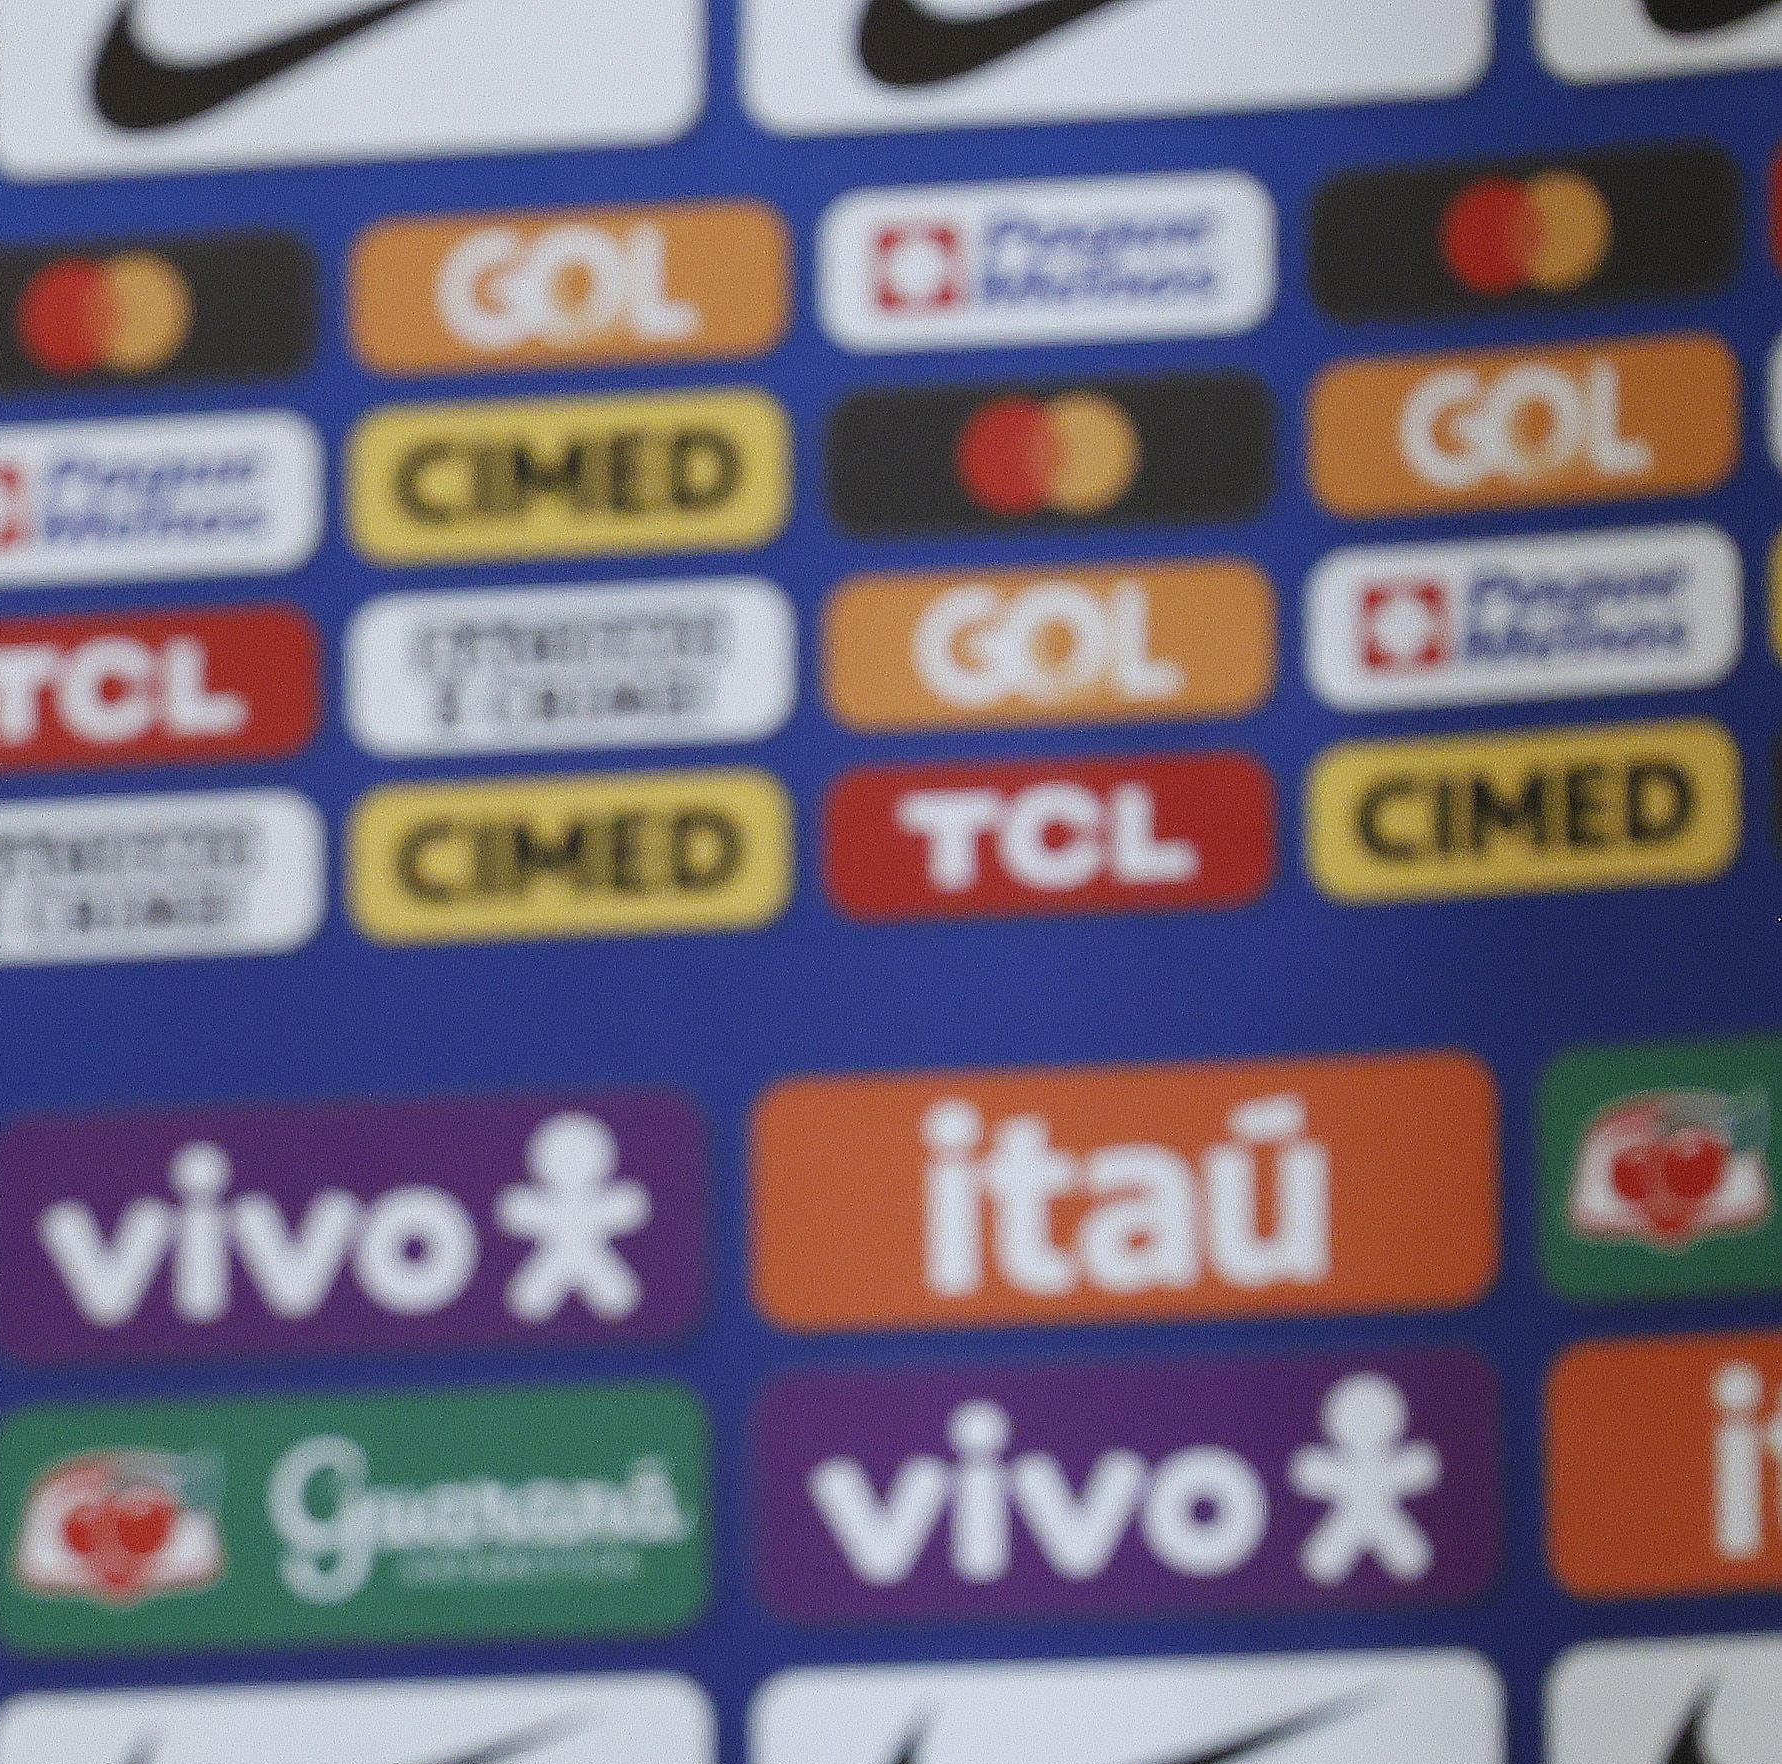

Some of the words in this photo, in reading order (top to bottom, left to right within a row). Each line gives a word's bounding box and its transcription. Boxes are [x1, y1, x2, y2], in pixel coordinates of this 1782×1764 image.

[437, 224, 698, 348] GOL
[394, 427, 745, 526] CIMED
[1398, 360, 1650, 488] GOL
[913, 582, 1181, 707] GOL
[395, 807, 747, 905] CIMED
[897, 783, 1196, 890] TCL
[1350, 761, 1695, 863] CIMED
[43, 1145, 476, 1323] vivo
[923, 1097, 1328, 1296] itaú
[812, 1403, 1265, 1582] vivo
